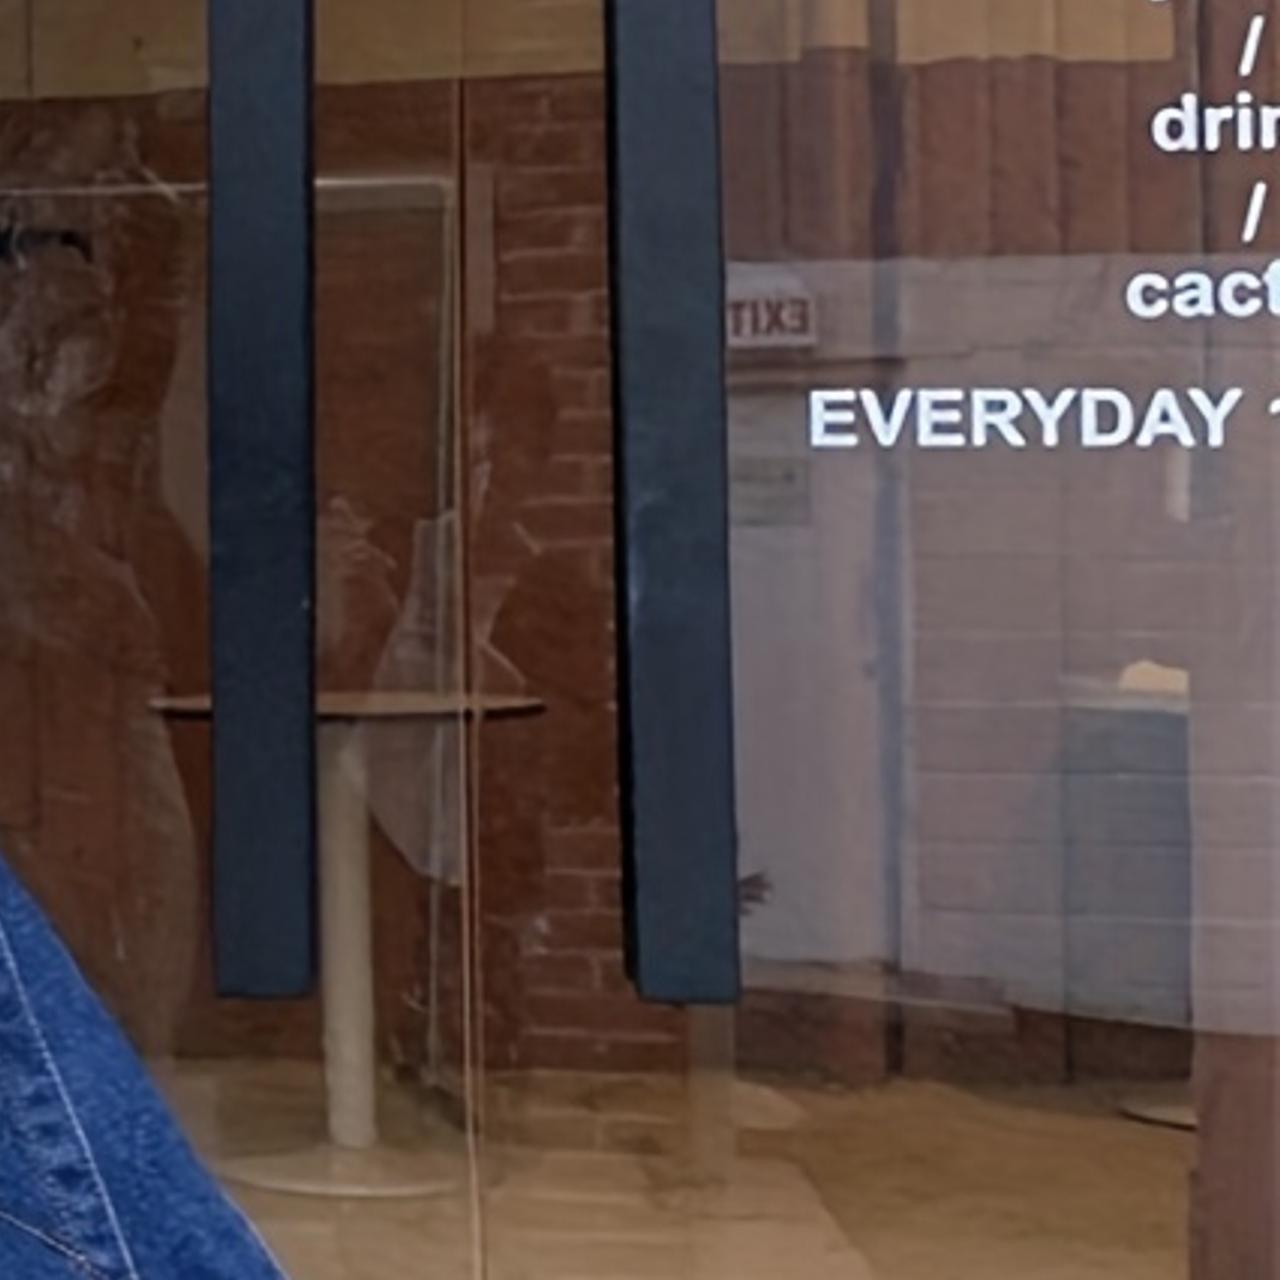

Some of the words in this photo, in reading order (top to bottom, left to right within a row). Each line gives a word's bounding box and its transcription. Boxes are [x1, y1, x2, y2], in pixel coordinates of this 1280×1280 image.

[1240, 15, 1264, 76] /
[1242, 181, 1267, 243] /
[809, 387, 1243, 447] EVERYDAY
